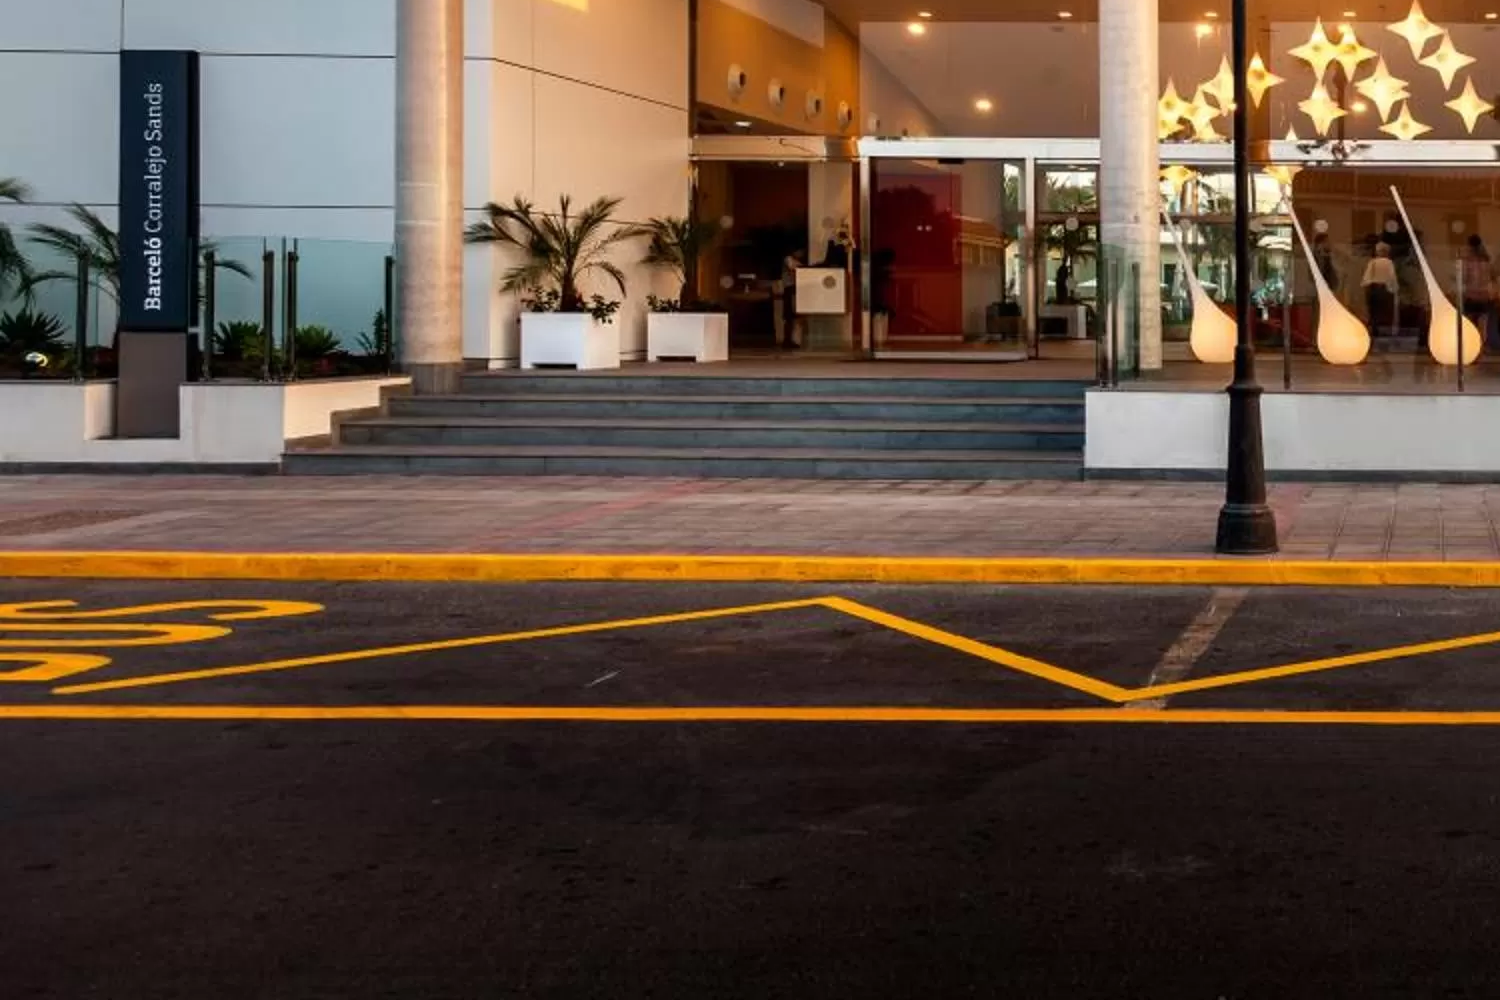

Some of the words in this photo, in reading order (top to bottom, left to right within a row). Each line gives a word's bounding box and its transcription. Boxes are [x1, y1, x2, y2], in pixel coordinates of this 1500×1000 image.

[143, 82, 163, 141] Sands
[143, 145, 167, 233] Corralejo
[143, 237, 162, 311] Barceló
